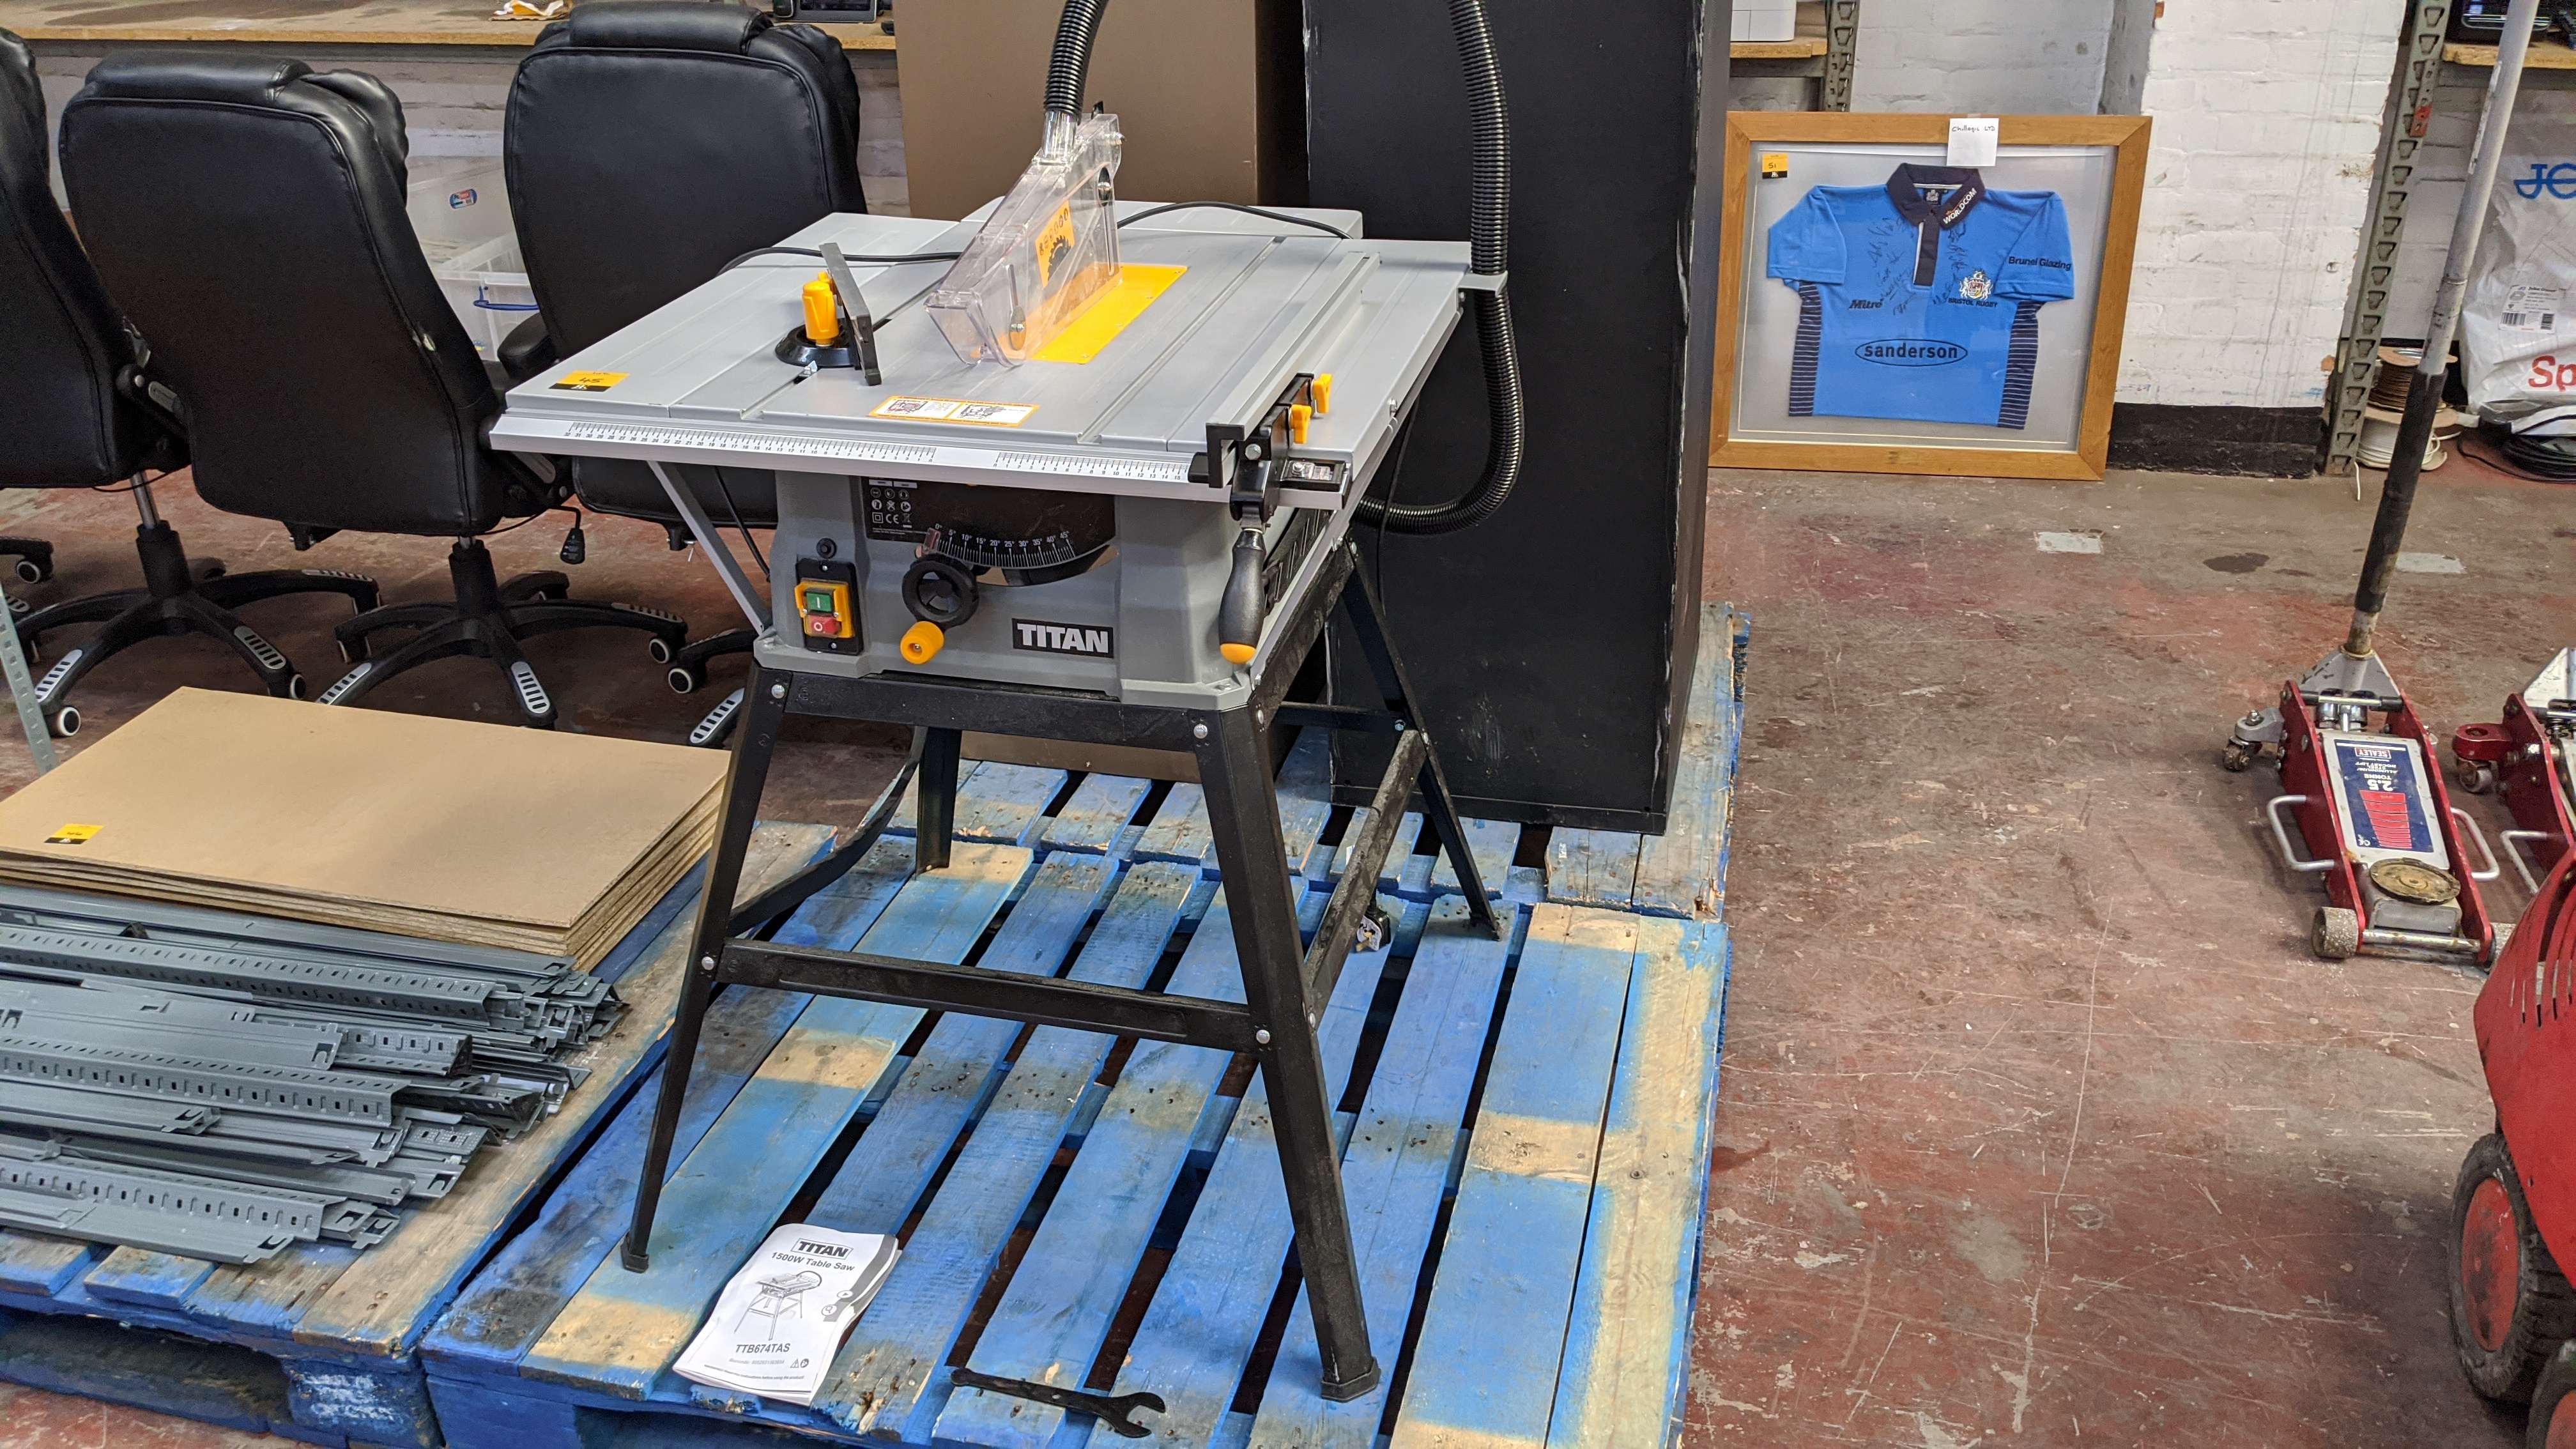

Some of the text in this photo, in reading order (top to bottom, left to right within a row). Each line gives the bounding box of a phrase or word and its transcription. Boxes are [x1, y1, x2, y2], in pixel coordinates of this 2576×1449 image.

[1943, 188, 1977, 224] WORLDCOM
[2009, 256, 2072, 271] Brunel Glazing
[1848, 300, 1883, 309] Mitre
[1949, 298, 1974, 306] BRISTOL
[1864, 342, 1958, 358] sanderson
[1016, 623, 1108, 654] TITAN
[2359, 749, 2388, 757] SEALEY
[2367, 779, 2393, 792] 2.5
[798, 1241, 849, 1257] TITAN
[772, 1252, 855, 1271] 1500W Table Saw
[735, 1343, 791, 1353] TTB674TAS
